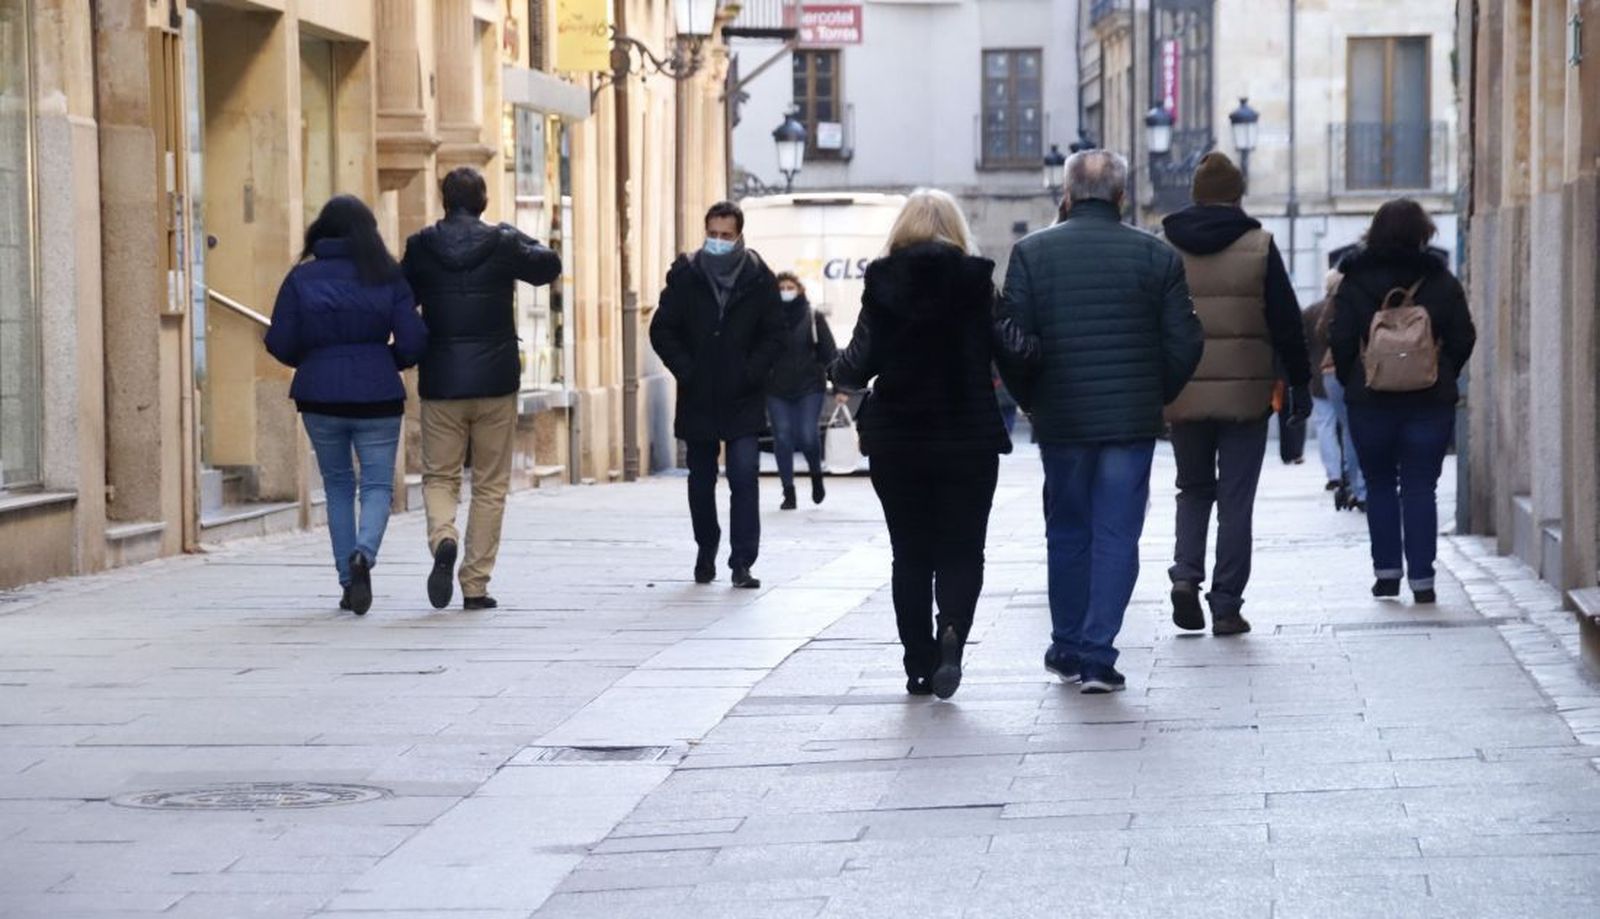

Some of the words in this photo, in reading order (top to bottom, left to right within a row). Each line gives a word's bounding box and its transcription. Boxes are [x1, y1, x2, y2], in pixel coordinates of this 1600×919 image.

[801, 10, 854, 25] ercotel
[816, 26, 859, 41] Torres
[1164, 41, 1175, 110] HOSTA
[824, 258, 867, 279] GLS
